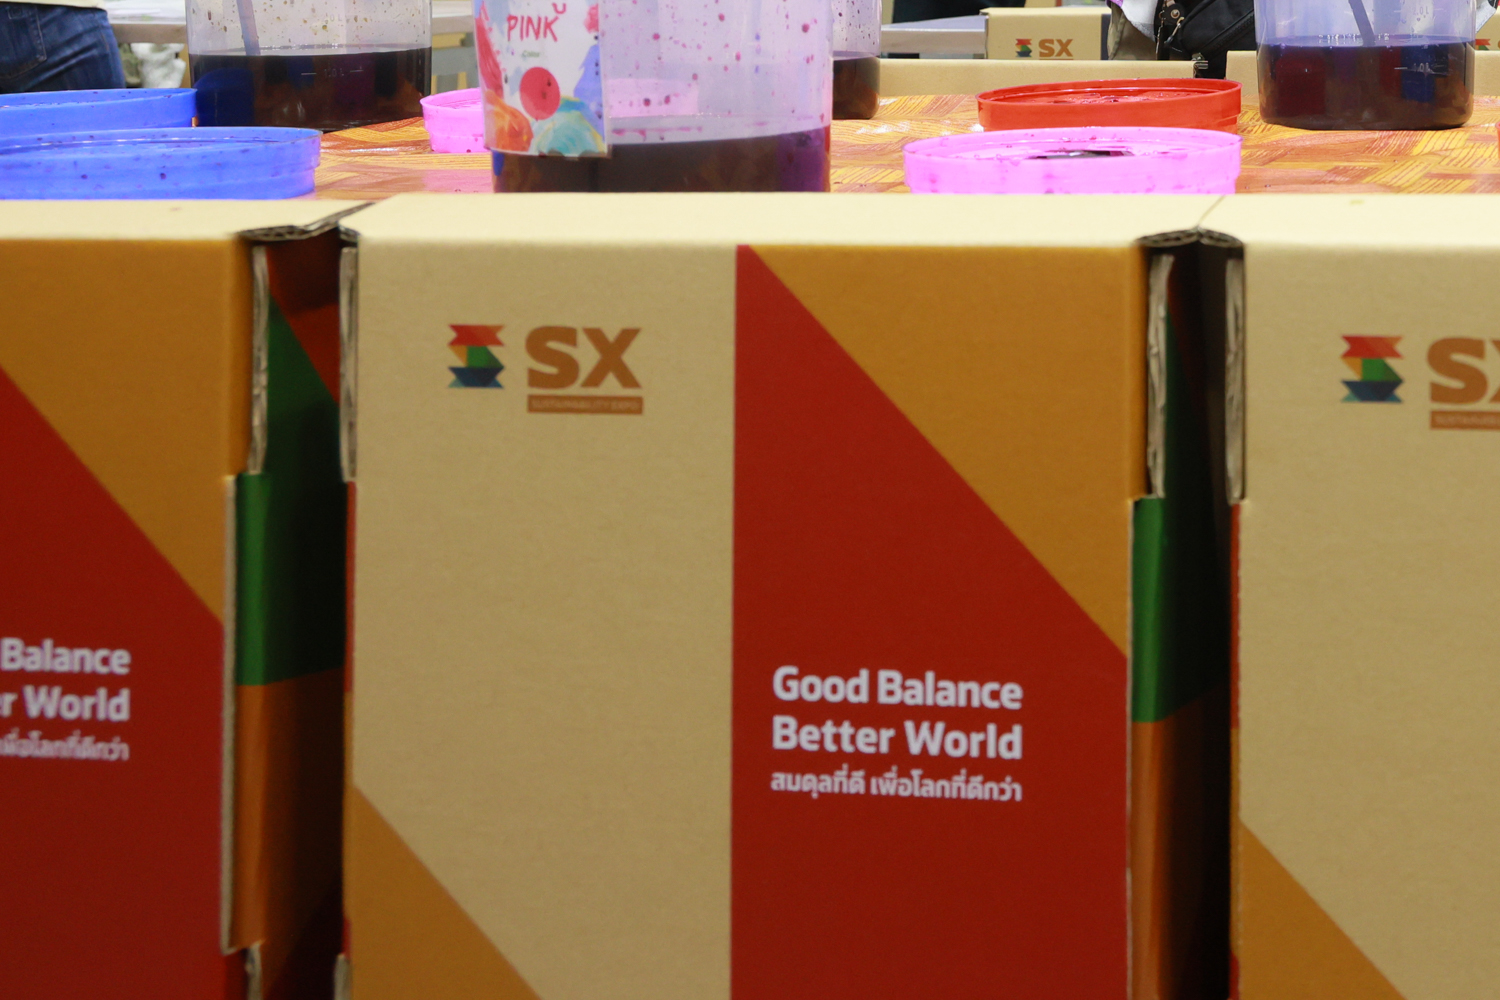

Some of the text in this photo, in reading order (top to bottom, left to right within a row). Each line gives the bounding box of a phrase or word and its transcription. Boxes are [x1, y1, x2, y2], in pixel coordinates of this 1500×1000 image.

[507, 15, 559, 42] PINK
[1038, 38, 1073, 57] SX
[525, 325, 642, 390] SX
[0, 637, 131, 675] Balance
[23, 684, 131, 722] World
[772, 665, 1023, 710] Good Balance
[772, 715, 1022, 760] Better World
[771, 763, 1022, 802] สมดุลที่ดี เพื่อโลกที่ดีกว่า
